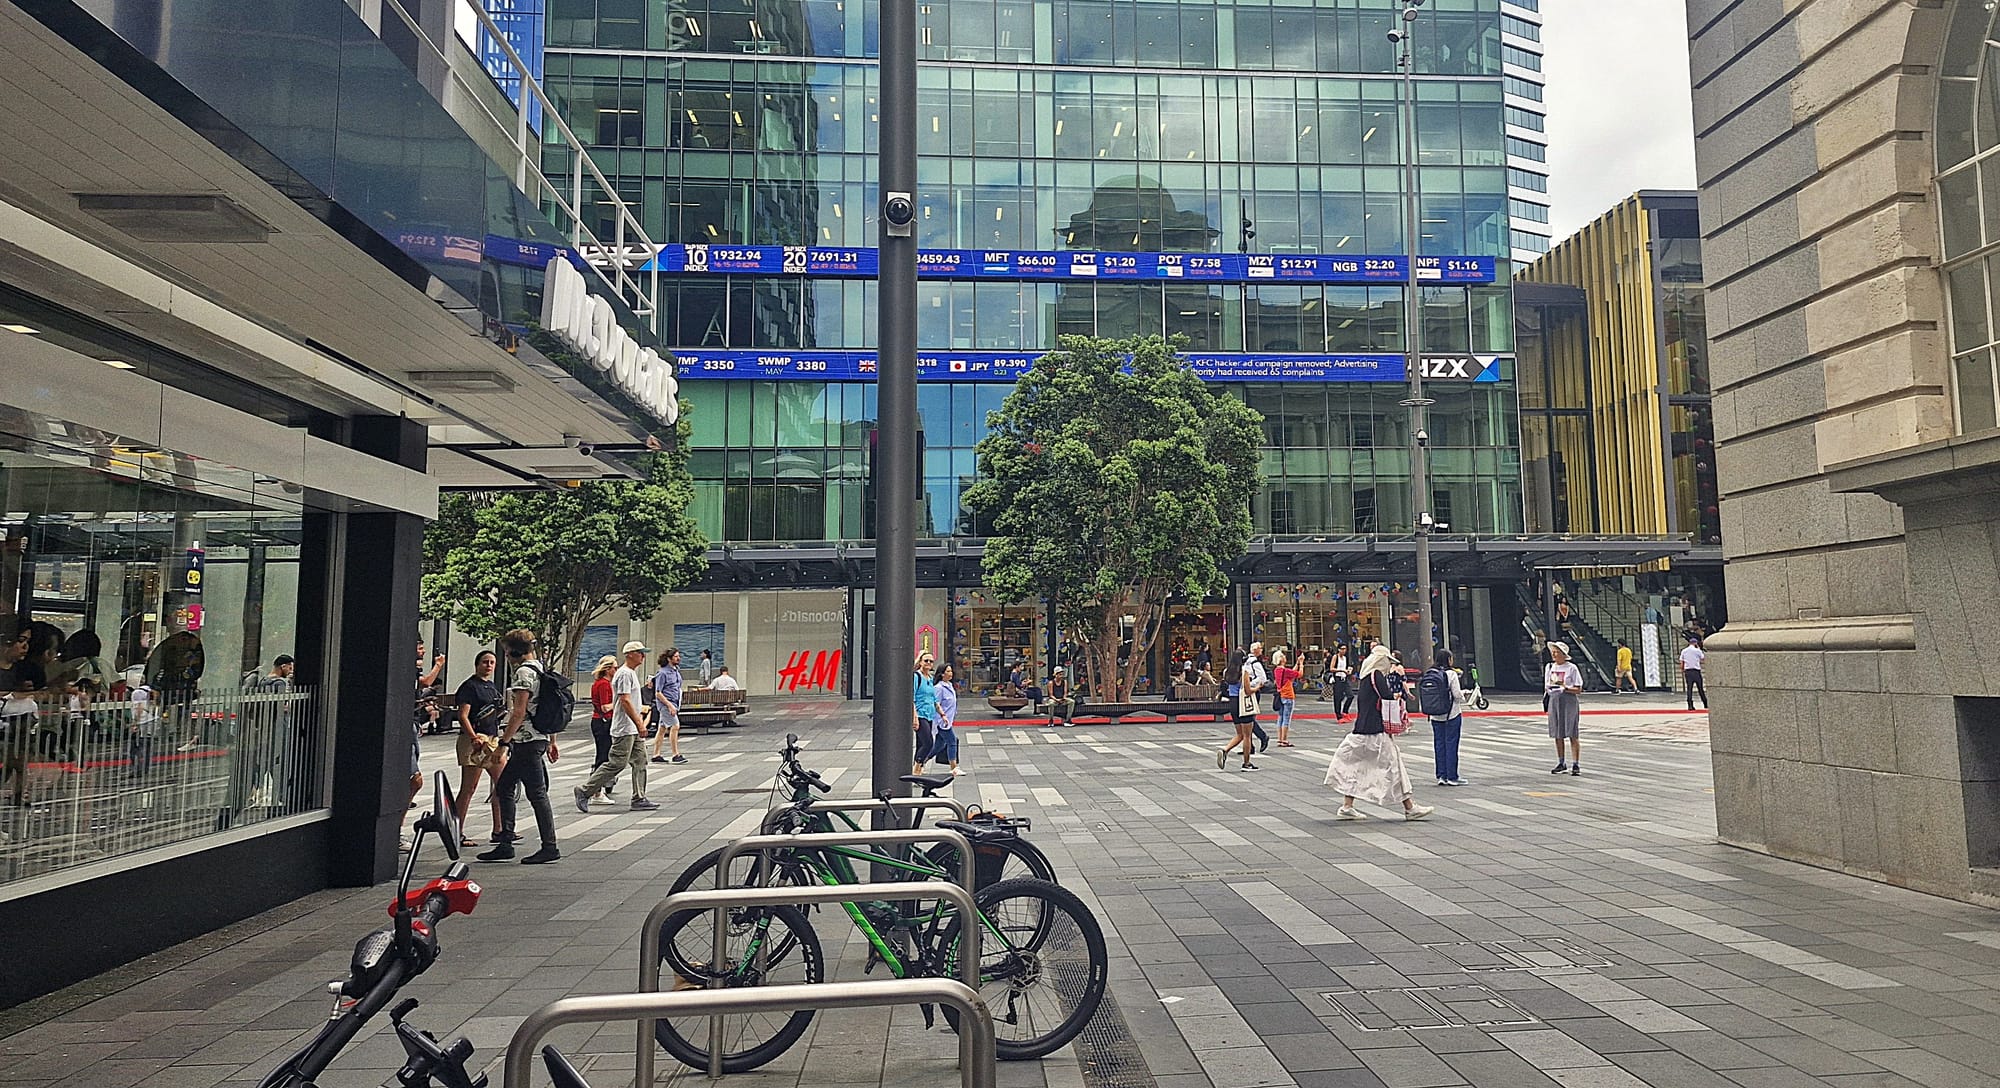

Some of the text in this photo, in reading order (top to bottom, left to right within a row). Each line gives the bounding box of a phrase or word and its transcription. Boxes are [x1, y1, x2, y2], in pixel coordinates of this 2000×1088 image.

[686, 250, 707, 265] 10
[713, 250, 762, 260] 1932.94
[783, 252, 807, 267] 20
[811, 252, 857, 262] 7691.31
[984, 253, 1056, 265] MFT $66.00
[1073, 254, 1136, 267] PCT $1.20
[1158, 255, 1221, 268] POT $7.58
[684, 264, 708, 272] INDEX
[1249, 256, 1317, 269] MZY $12.91
[1333, 260, 1395, 272] NGB $2.20
[1417, 258, 1478, 270] NPF $1.16
[677, 357, 735, 370] MP 3350
[757, 357, 826, 371] SWMP 3380
[970, 359, 1026, 371] JPY 89.390
[1195, 359, 1214, 367] KFC
[1214, 359, 1241, 367] hacker
[1255, 360, 1293, 369] campaign
[1295, 360, 1332, 369] removed;
[1334, 360, 1378, 370] Advertising
[1407, 358, 1470, 378] NZX
[1217, 368, 1233, 376] had
[1234, 368, 1268, 376] received
[1269, 368, 1280, 376] 65
[1282, 369, 1325, 378] complaints
[778, 649, 843, 692] H&M
[805, 944, 815, 984] MAXXI
